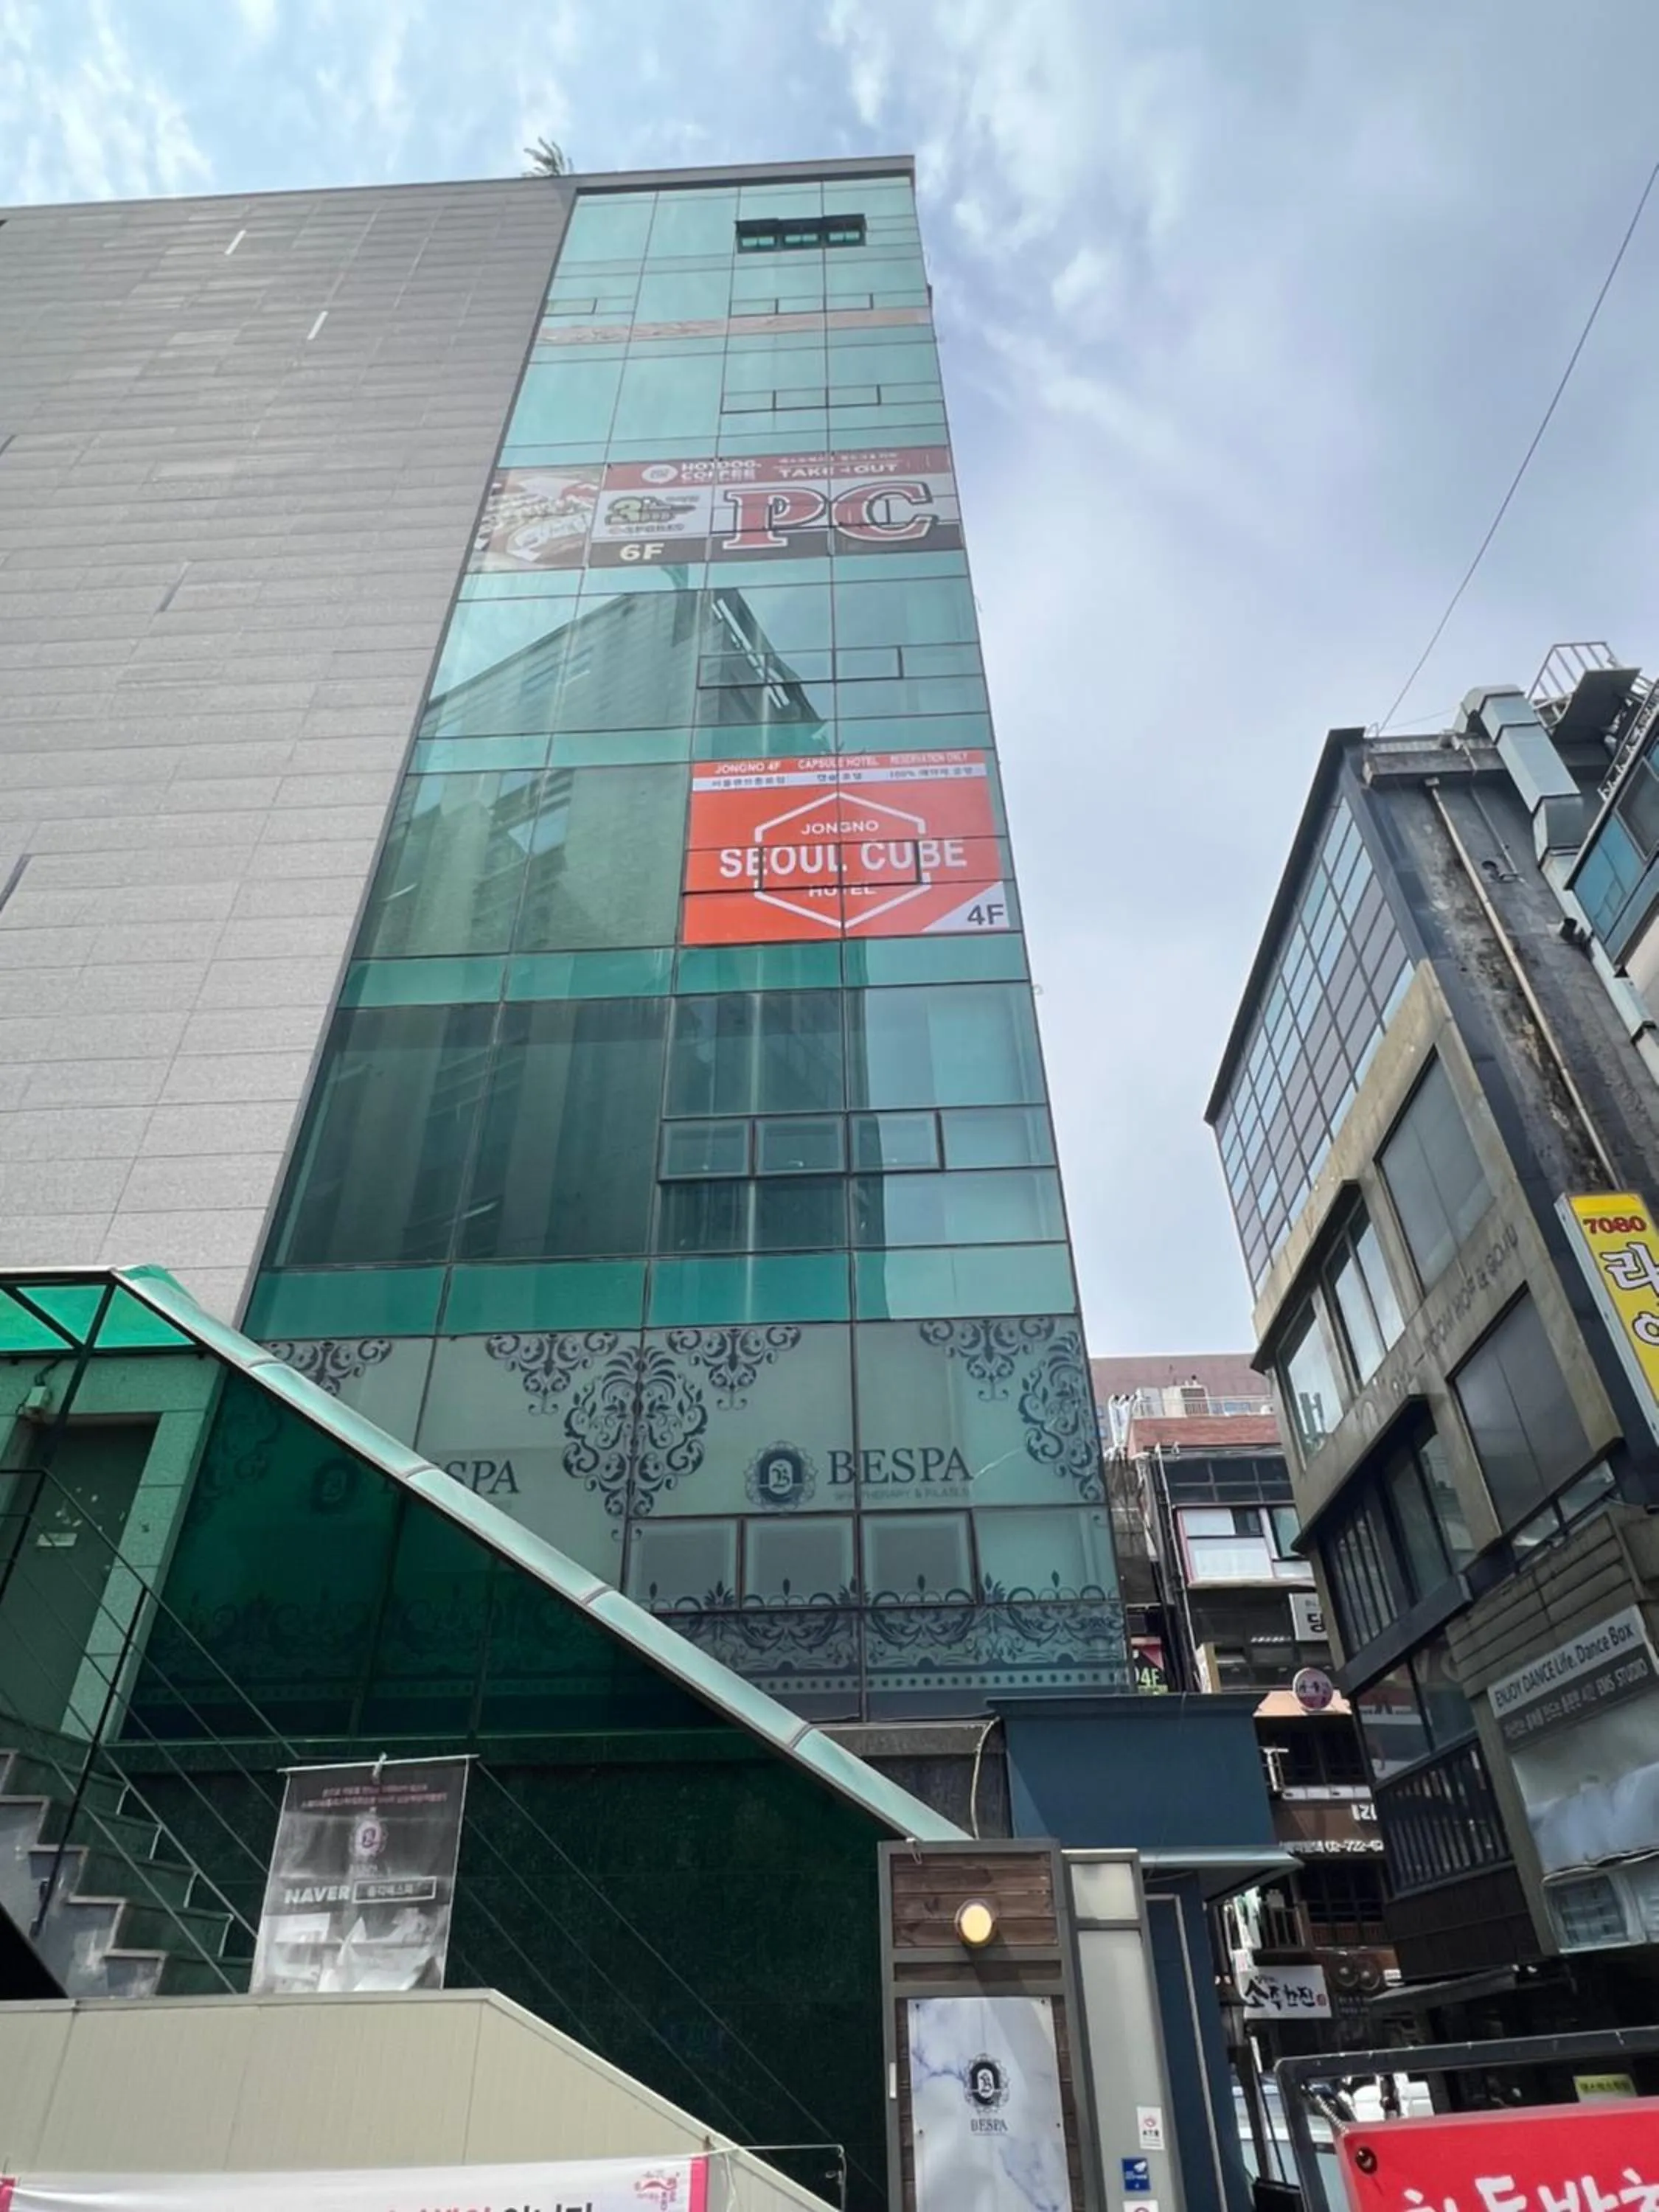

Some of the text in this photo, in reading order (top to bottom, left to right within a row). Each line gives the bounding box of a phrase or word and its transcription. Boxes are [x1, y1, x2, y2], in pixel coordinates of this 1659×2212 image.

[723, 481, 937, 550] PC
[619, 543, 664, 561] 6F
[715, 762, 765, 774] JONGNO
[797, 755, 843, 770] CAPSULE
[800, 820, 880, 835] JONGNO
[720, 839, 968, 879] SEOUL CUBE
[967, 905, 1004, 925] 4F
[1583, 1217, 1646, 1234] 7080
[827, 1447, 974, 1485] BESPA
[1607, 1624, 1635, 1646] Box
[285, 1885, 350, 1905] NAVER
